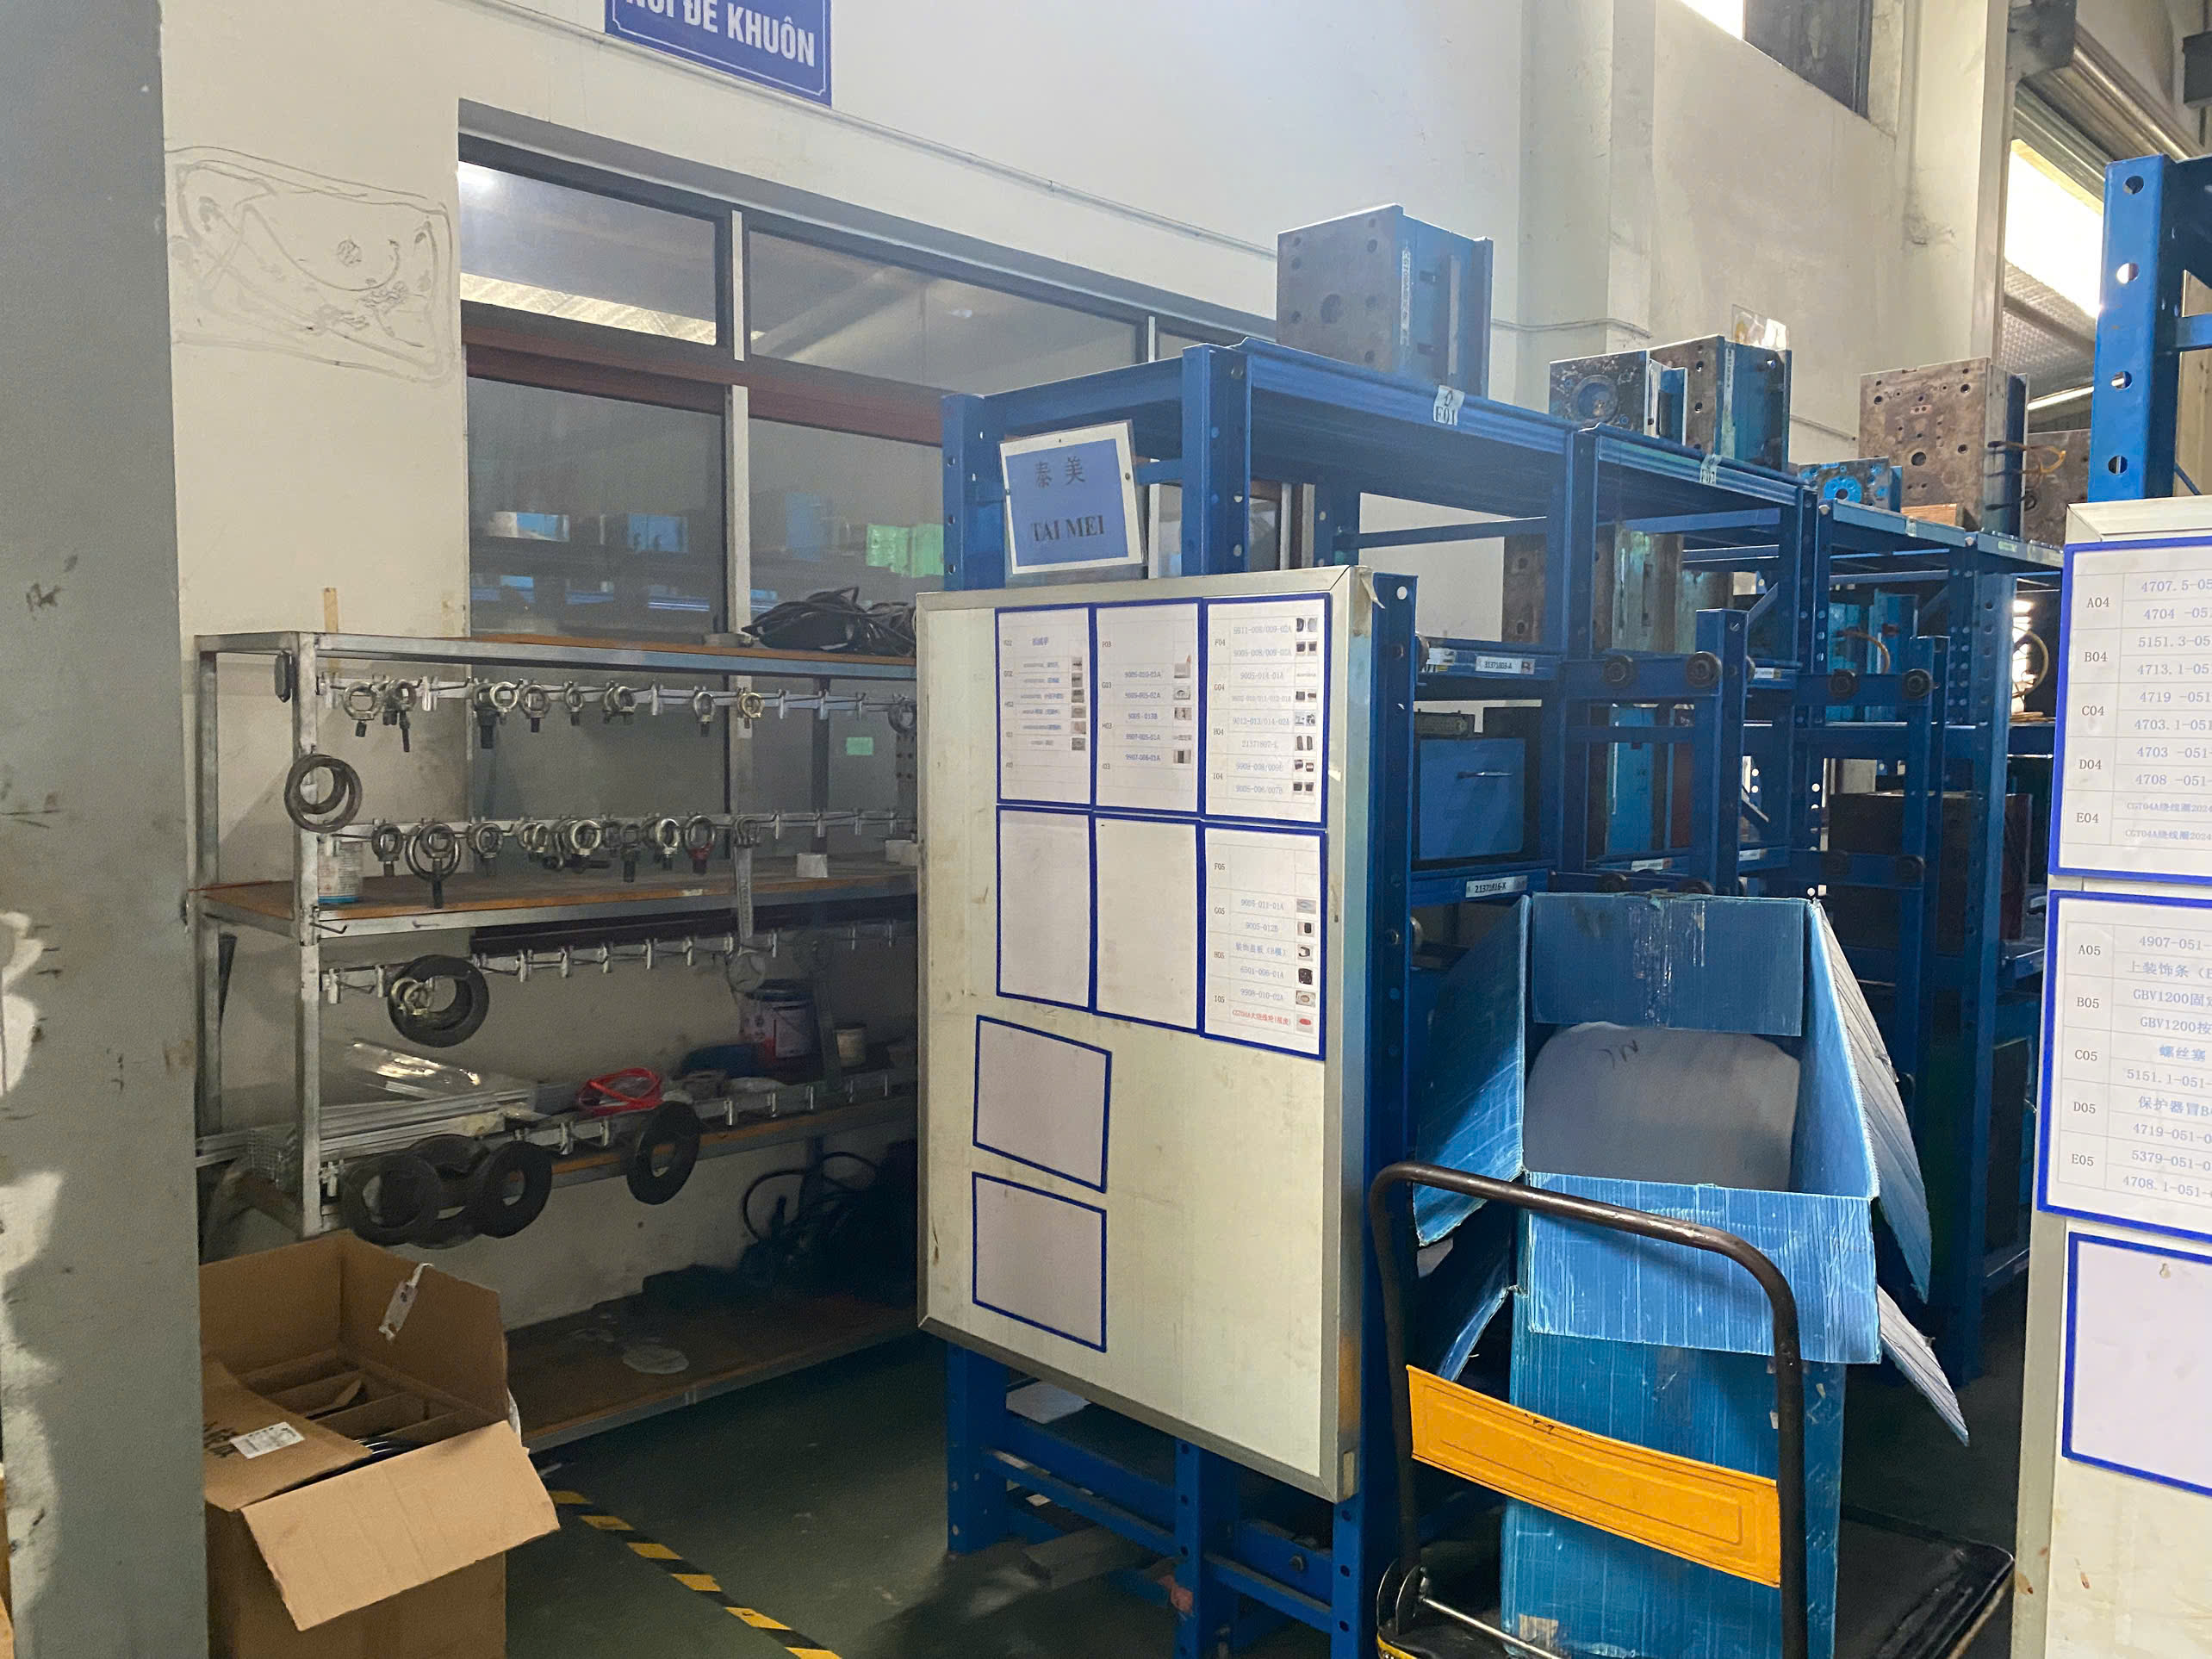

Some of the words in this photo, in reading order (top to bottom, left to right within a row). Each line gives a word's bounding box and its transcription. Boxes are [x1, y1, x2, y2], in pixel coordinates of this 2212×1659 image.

[727, 3, 815, 68] KHUÔN
[1030, 519, 1060, 542] TAI
[1066, 514, 1105, 537] MEI
[2086, 597, 2109, 608] A04
[2143, 608, 2175, 620] 4704
[2184, 606, 2212, 619] -05
[2084, 651, 2108, 662] B04
[2140, 692, 2172, 703] 4719
[2081, 705, 2104, 716] C04
[2137, 747, 2168, 758] 4703
[2079, 759, 2102, 770] D04
[2135, 774, 2167, 786] 4708
[2076, 812, 2099, 823] E04
[1214, 862, 1226, 871] F05
[2078, 944, 2101, 956] A05
[2077, 997, 2100, 1009] B05
[2074, 1049, 2097, 1061] C05
[2073, 1102, 2096, 1114] D05
[2072, 1153, 2095, 1167] E05
[2122, 1176, 2212, 1198] 4708.1-051-
